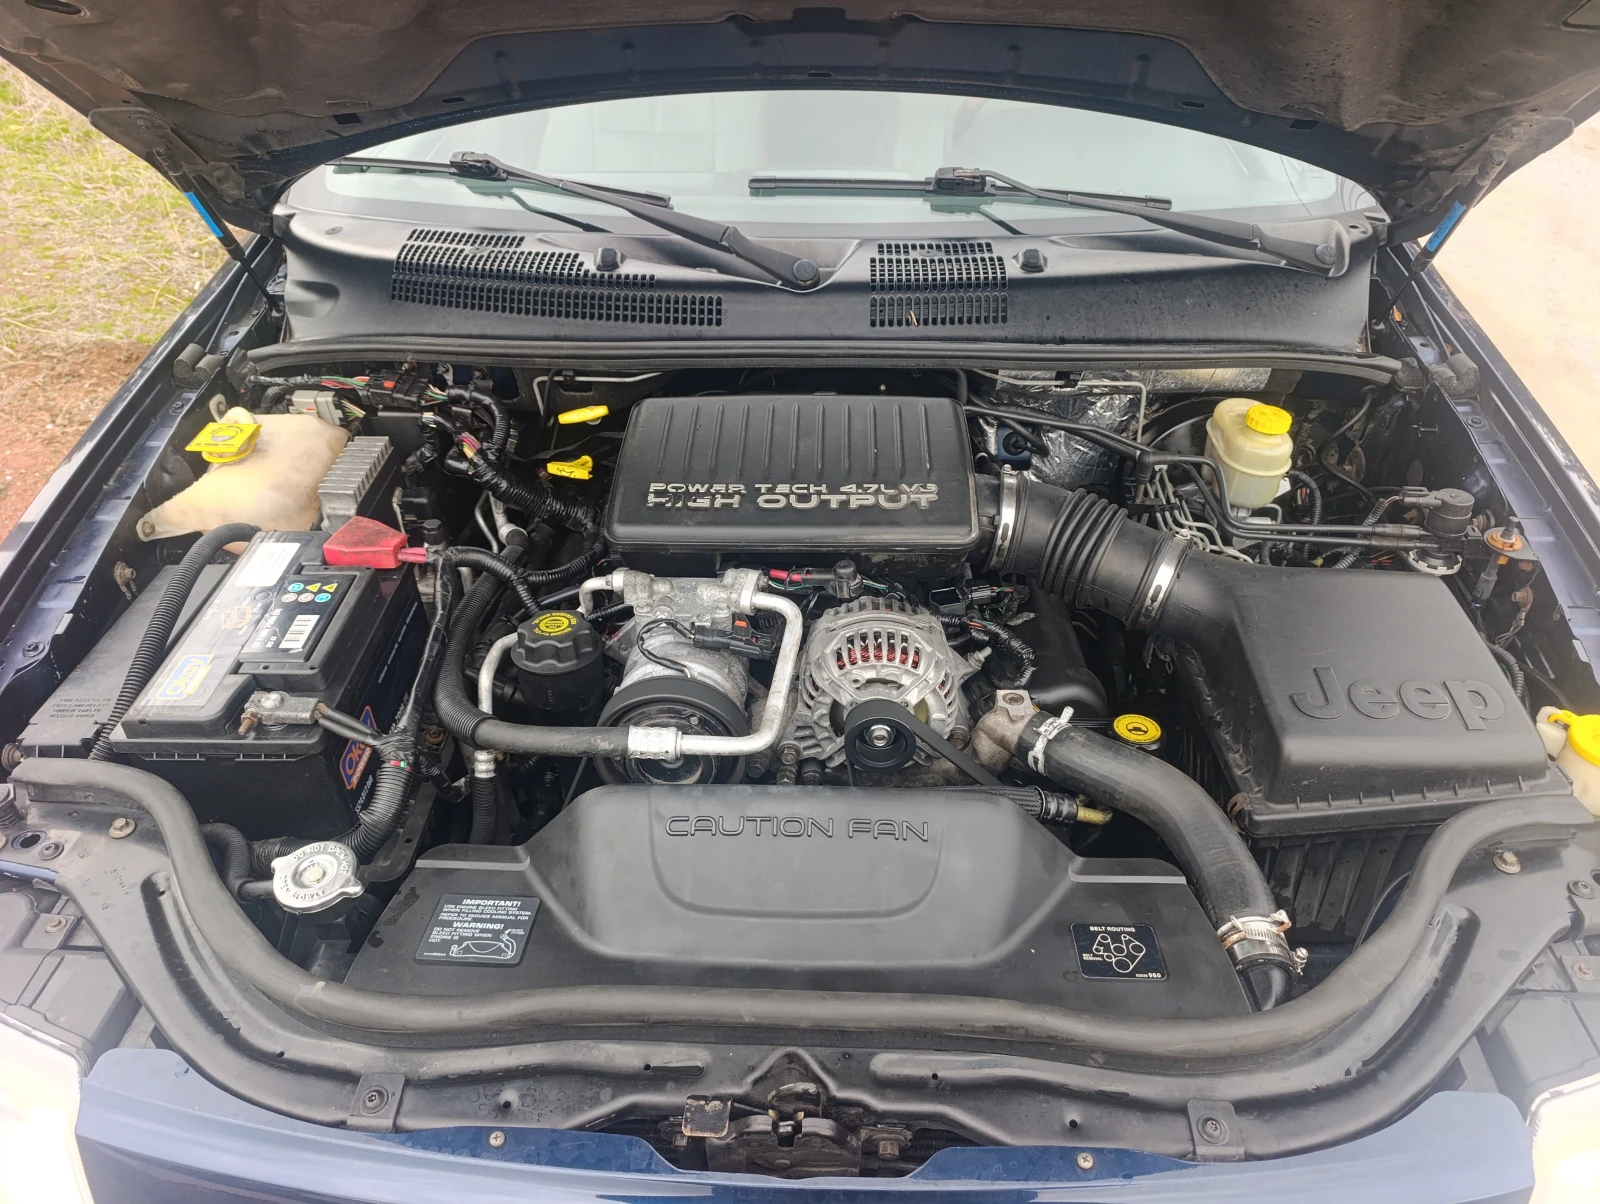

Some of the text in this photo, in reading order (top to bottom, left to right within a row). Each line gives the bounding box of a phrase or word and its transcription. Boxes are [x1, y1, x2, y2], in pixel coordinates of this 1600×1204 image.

[648, 482, 747, 494] POWER
[754, 483, 828, 494] TECH
[839, 483, 898, 495] 4.7L
[646, 493, 939, 509] HIGH OUTPUT
[1289, 666, 1505, 730] Jeep
[665, 815, 929, 842] CAUTION FAN
[308, 844, 325, 853] NOT
[327, 845, 349, 860] OPEN
[462, 898, 522, 907] IMPORTANT!
[452, 921, 505, 930] WARNING!
